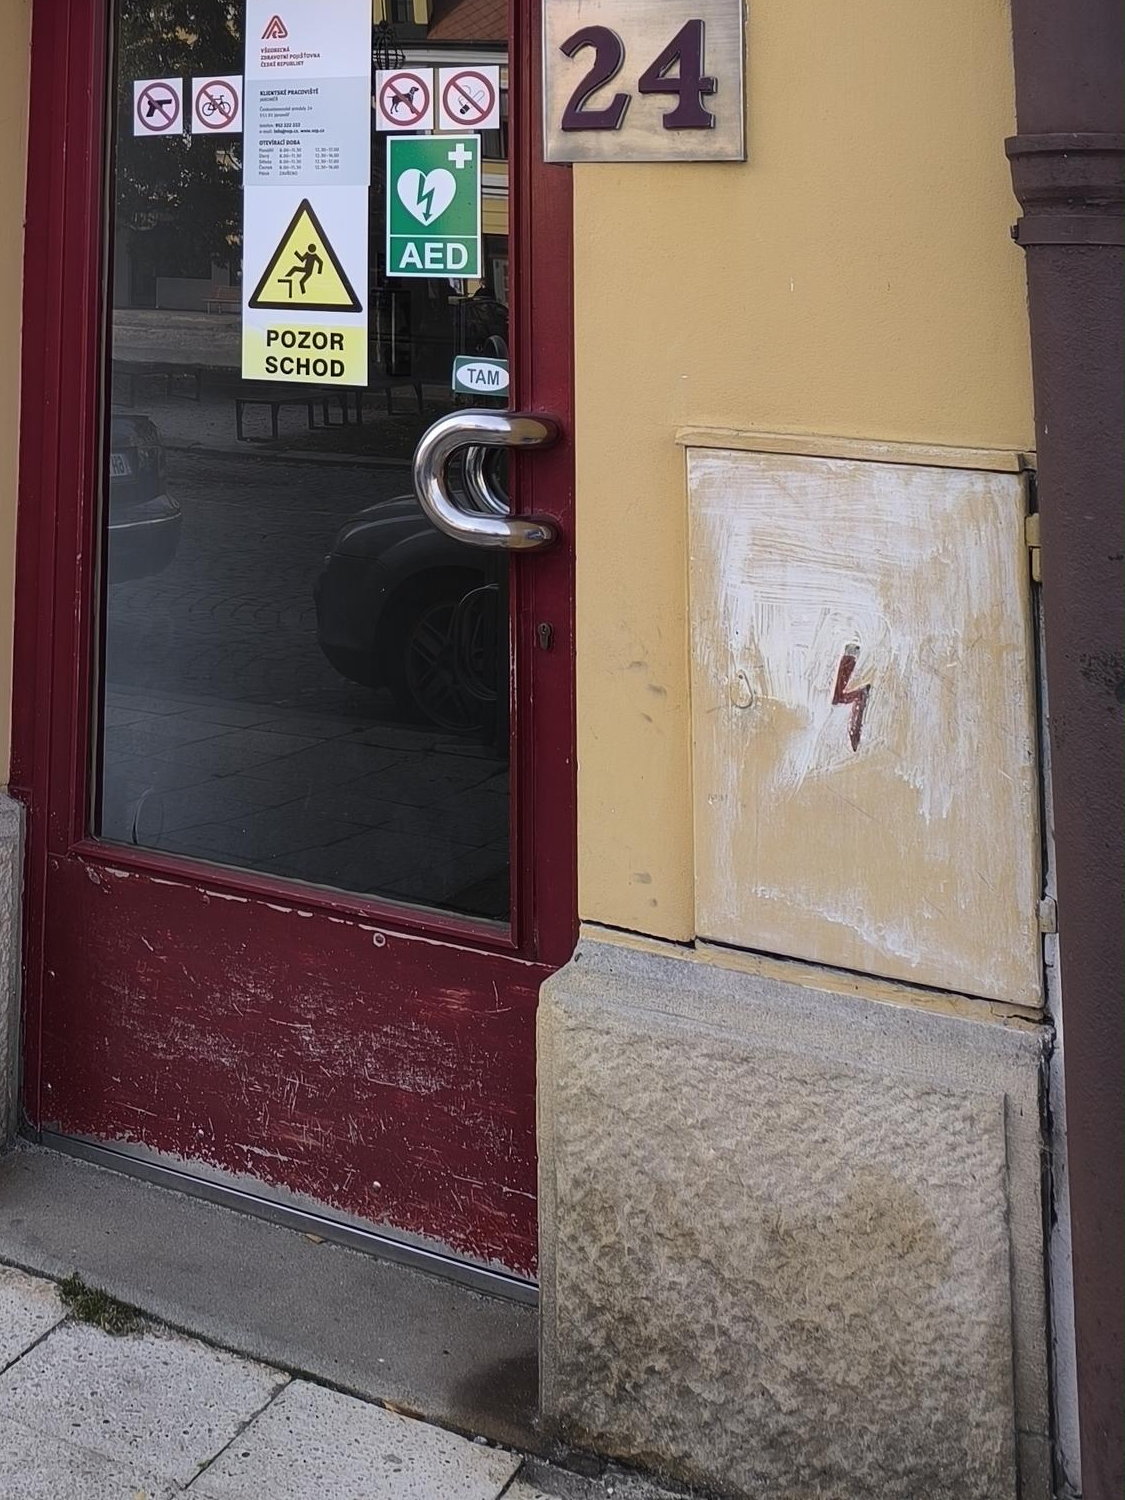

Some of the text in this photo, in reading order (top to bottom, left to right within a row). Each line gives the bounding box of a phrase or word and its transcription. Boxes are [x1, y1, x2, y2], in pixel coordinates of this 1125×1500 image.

[559, 18, 718, 132] 24
[399, 242, 468, 270] AED
[266, 329, 344, 351] POZOR
[265, 356, 345, 378] SCHOD
[467, 368, 500, 386] TAM
